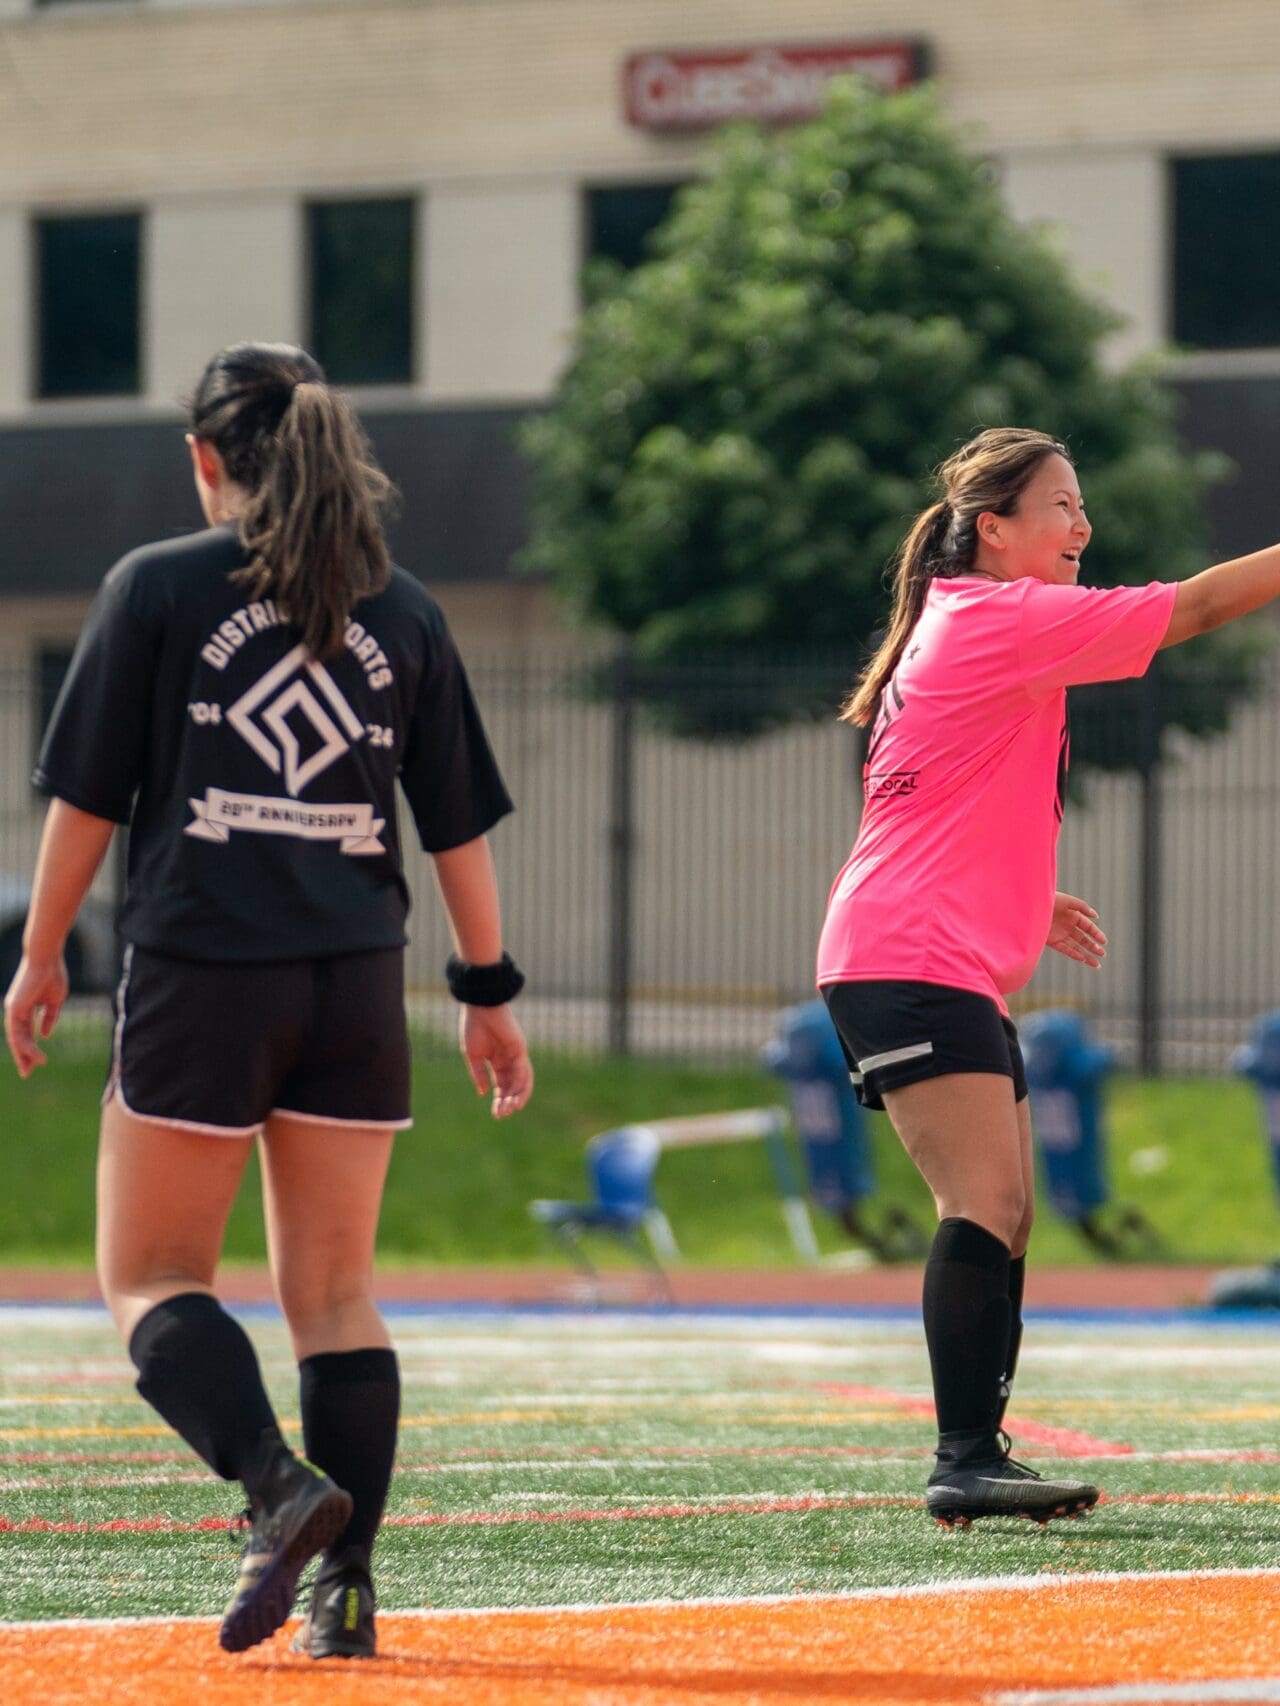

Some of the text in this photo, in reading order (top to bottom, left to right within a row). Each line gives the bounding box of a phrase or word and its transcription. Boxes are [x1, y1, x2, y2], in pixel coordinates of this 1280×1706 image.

[201, 600, 394, 690] DISTRI ORTS
[258, 805, 357, 828] ANNIERSARY
